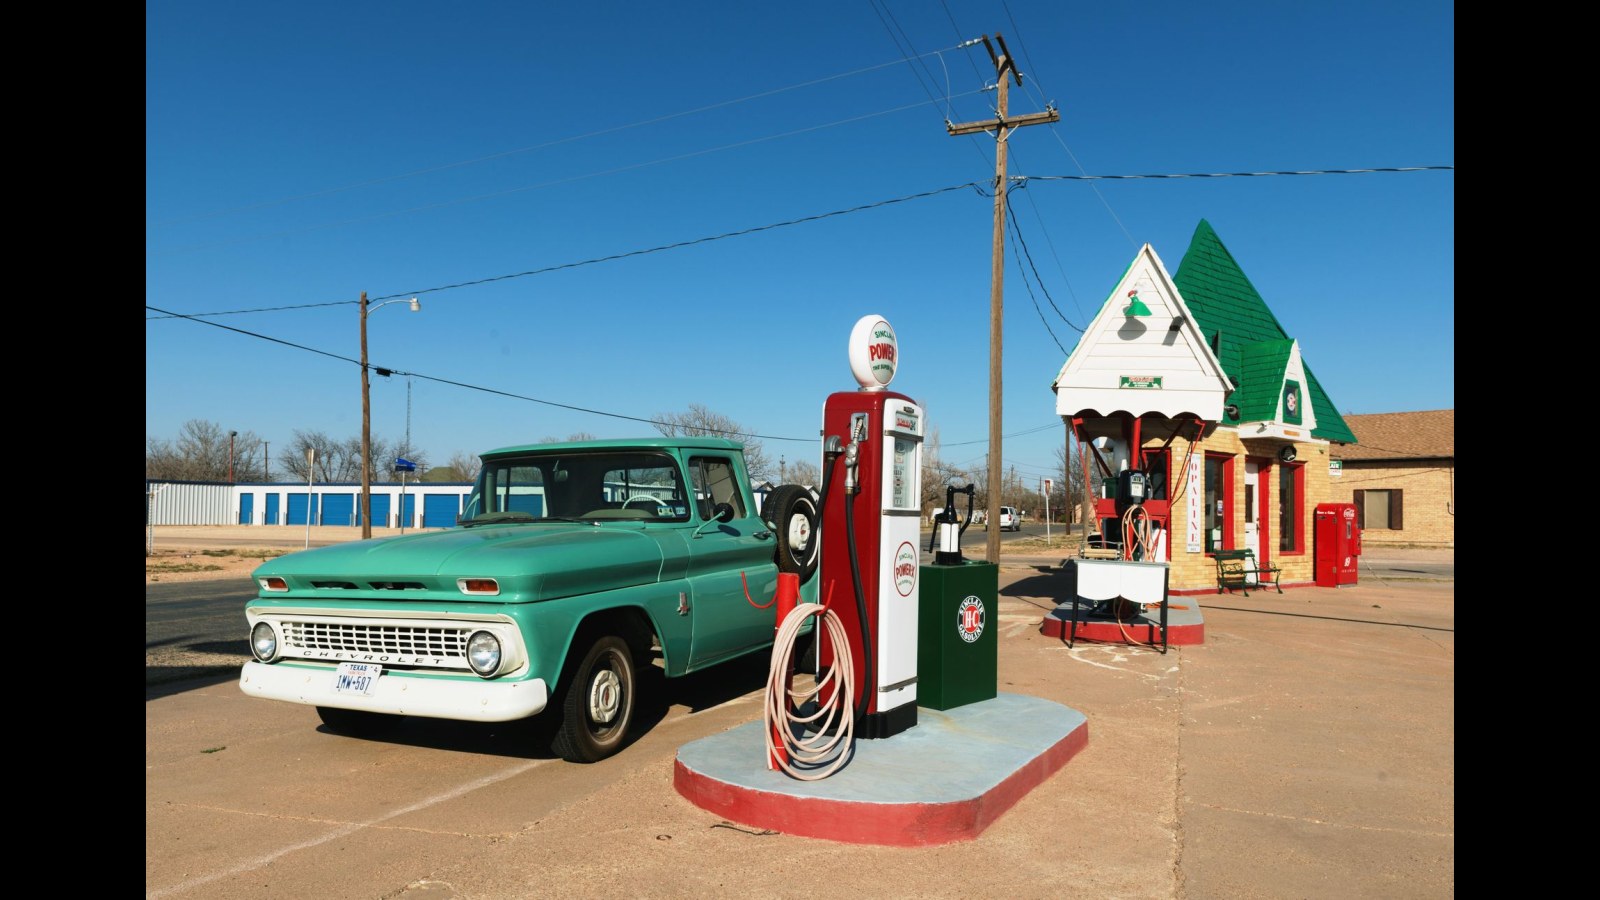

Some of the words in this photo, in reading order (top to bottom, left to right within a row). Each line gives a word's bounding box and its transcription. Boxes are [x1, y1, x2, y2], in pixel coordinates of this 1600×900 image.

[1190, 463, 1199, 542] OPALINE
[960, 597, 984, 615] SINCLAIR
[959, 622, 984, 641] GASOLINE
[303, 650, 444, 664] CHEVROLET
